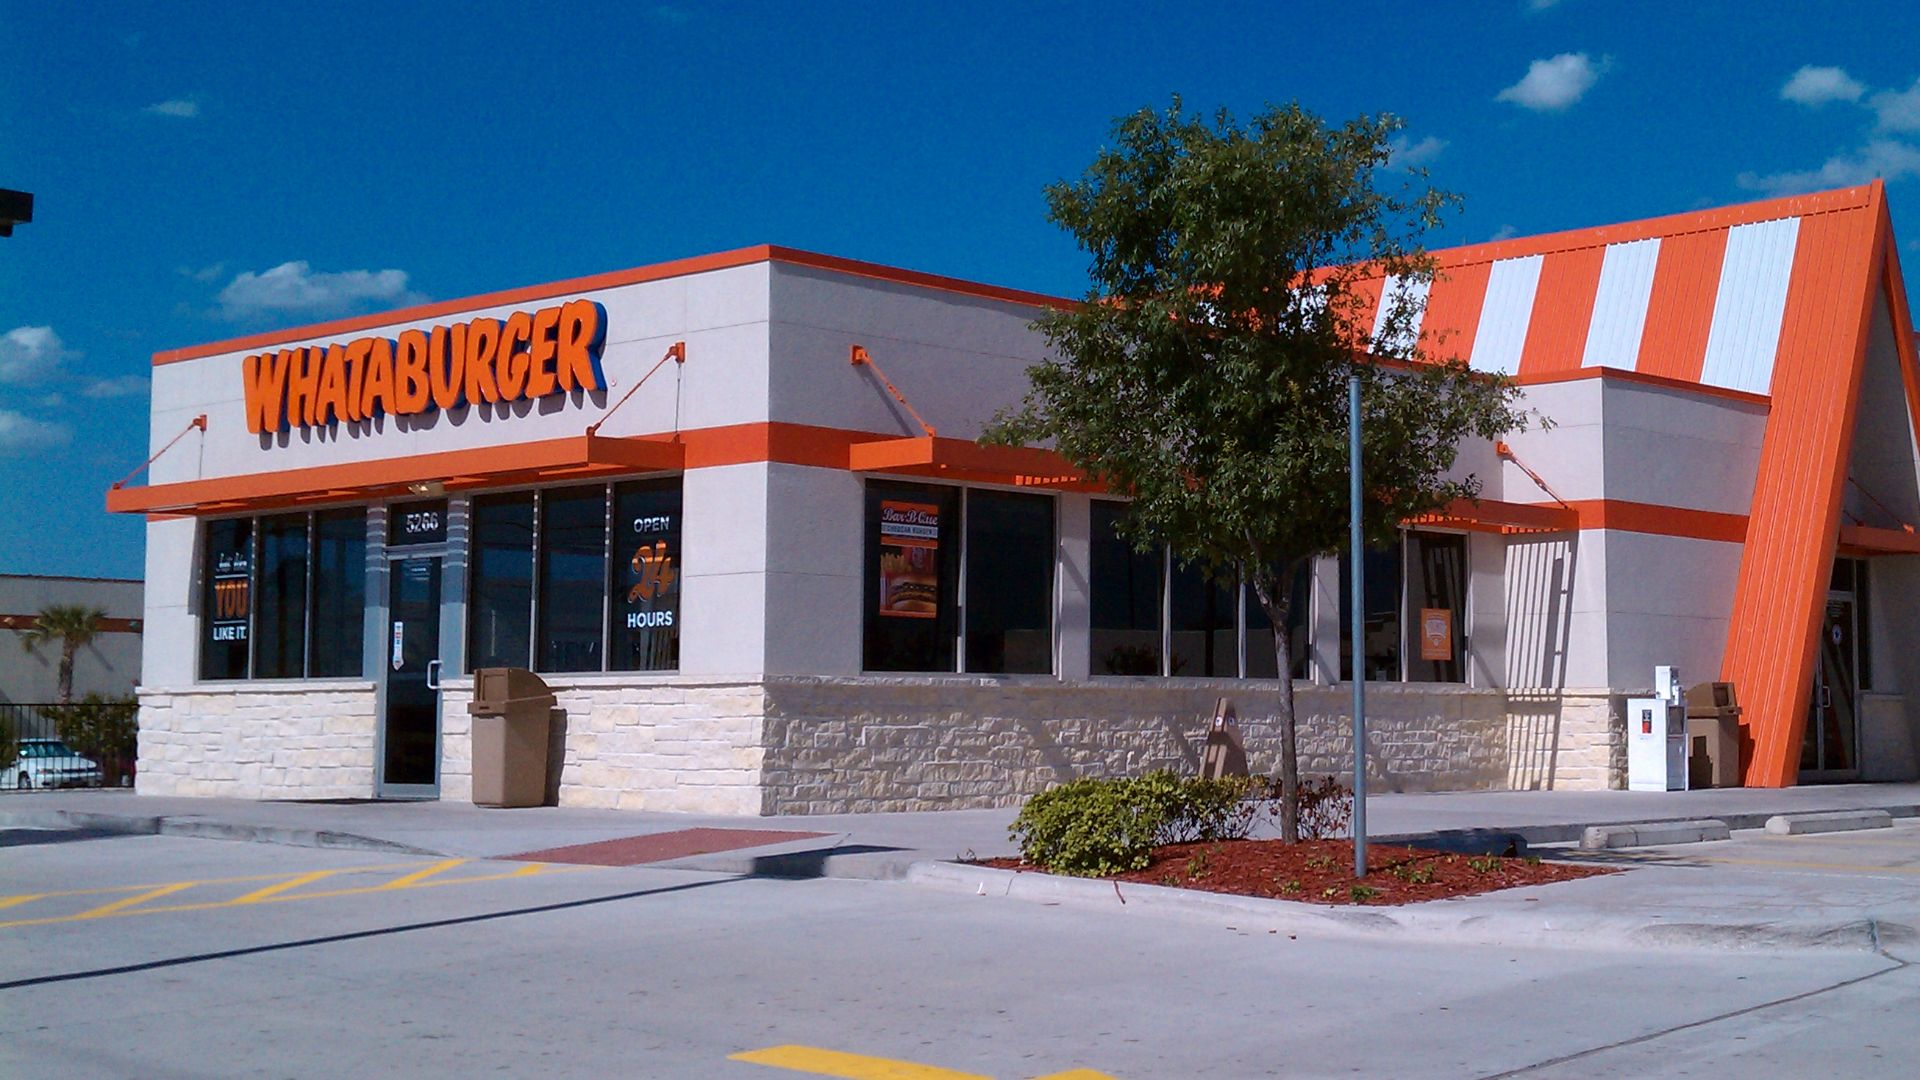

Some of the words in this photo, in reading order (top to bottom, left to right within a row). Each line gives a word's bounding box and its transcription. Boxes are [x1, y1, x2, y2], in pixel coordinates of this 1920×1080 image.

[242, 299, 606, 434] WHATABURGER
[406, 512, 439, 533] 5266
[633, 516, 670, 533] OPEN
[627, 538, 675, 604] 24
[214, 580, 248, 619] YOU
[627, 610, 673, 628] HOURS
[213, 626, 235, 641] LIKE
